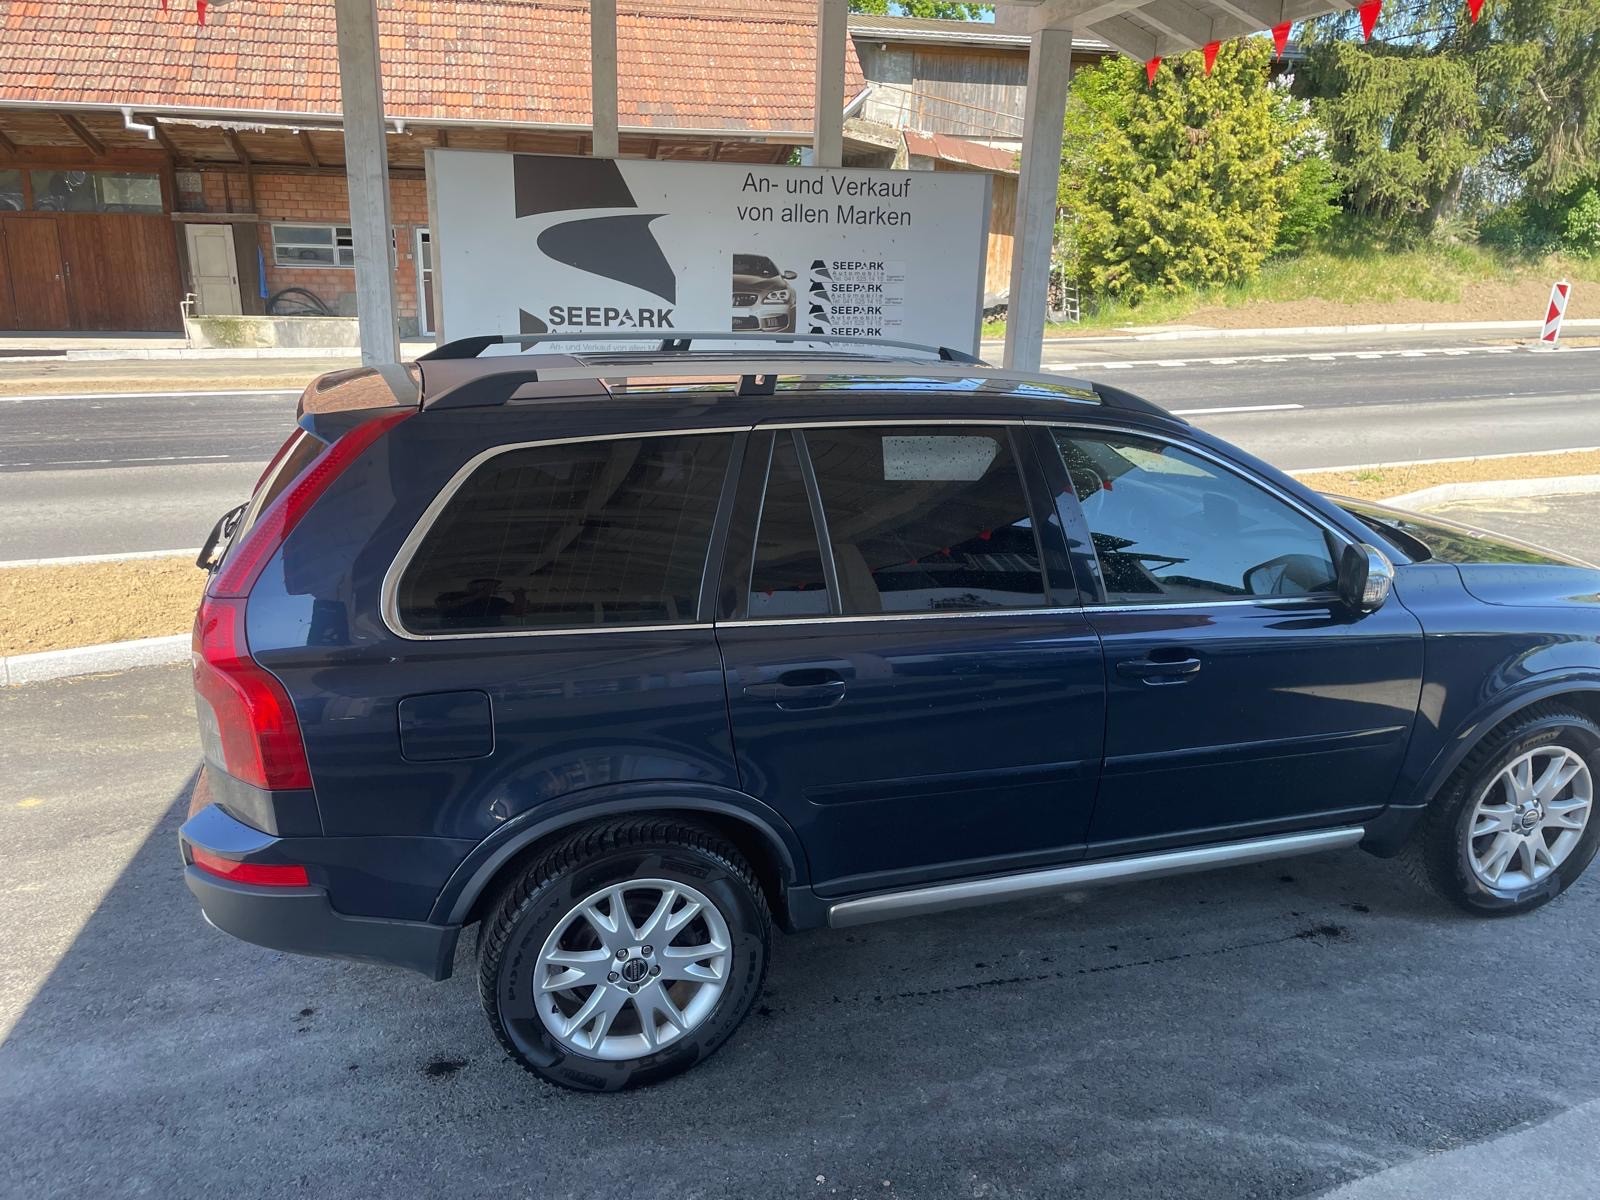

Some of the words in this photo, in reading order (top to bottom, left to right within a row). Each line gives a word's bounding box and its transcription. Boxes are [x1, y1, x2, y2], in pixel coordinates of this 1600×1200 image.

[742, 172, 779, 193] An-
[786, 176, 824, 195] und
[831, 176, 912, 197] Verkauf
[737, 206, 773, 221] von
[781, 204, 829, 223] allen
[837, 205, 911, 226] Marken
[832, 261, 885, 271] SEEPARK
[831, 283, 883, 293] SEEPARK
[830, 306, 882, 315] SEEPARK
[549, 306, 675, 328] SEEPARK
[830, 327, 882, 337] SEEPARK
